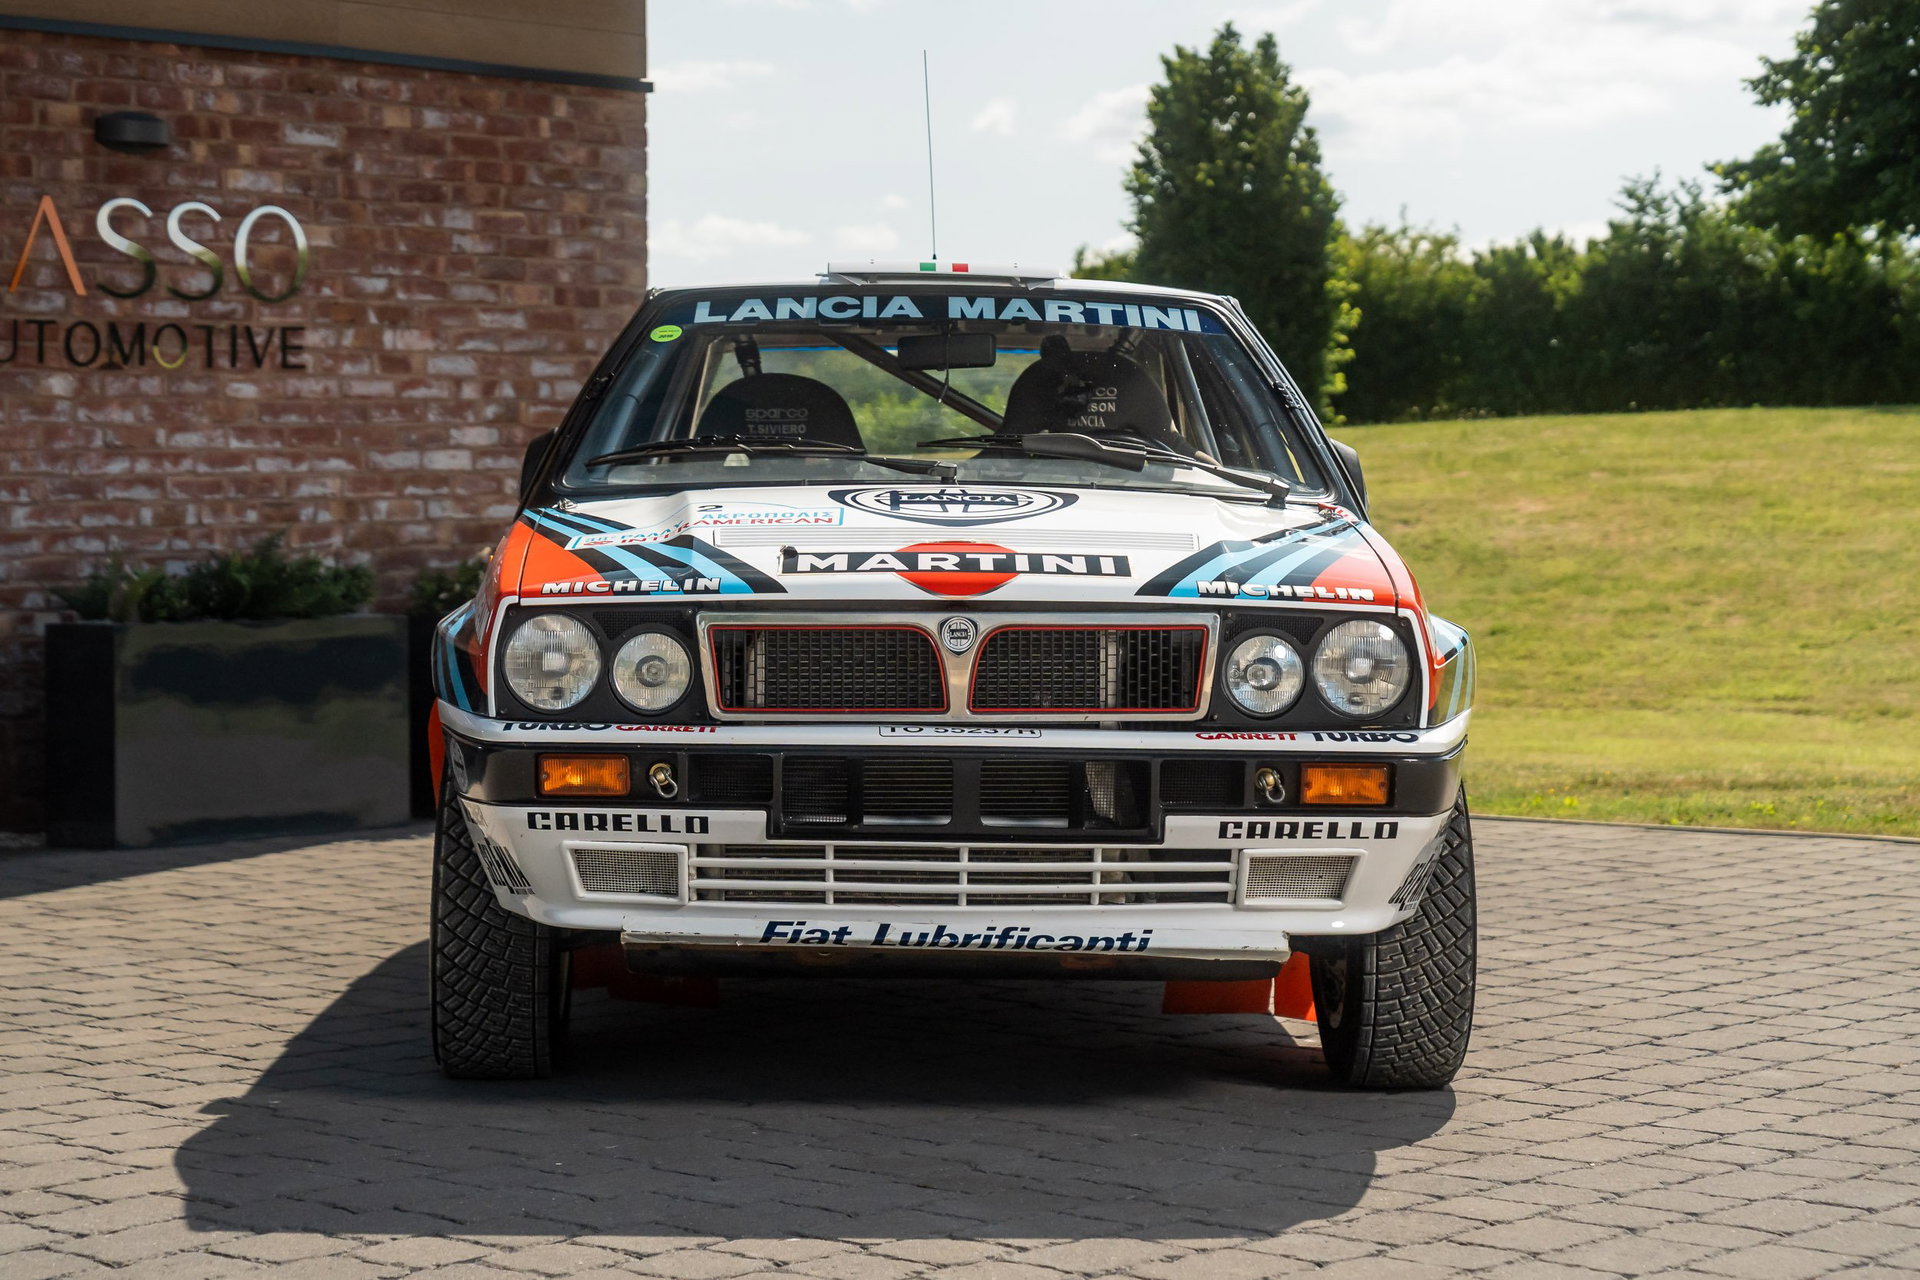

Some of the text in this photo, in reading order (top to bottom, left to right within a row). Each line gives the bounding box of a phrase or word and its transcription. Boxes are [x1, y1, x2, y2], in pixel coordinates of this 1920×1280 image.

[7, 195, 309, 302] ASSO
[693, 296, 1203, 332] LANCIA MARTINI
[698, 504, 723, 513] 2
[898, 494, 1018, 503] LANCIA
[796, 553, 1117, 575] MARTINI
[541, 577, 722, 595] MICHELIN
[1196, 580, 1376, 601] MICHELIN
[1195, 731, 1420, 743] GARRETT TURBO
[527, 811, 709, 834] CARELLO
[1218, 821, 1399, 839] CARELLO
[759, 920, 1154, 953] Fiat Lubrificanti
